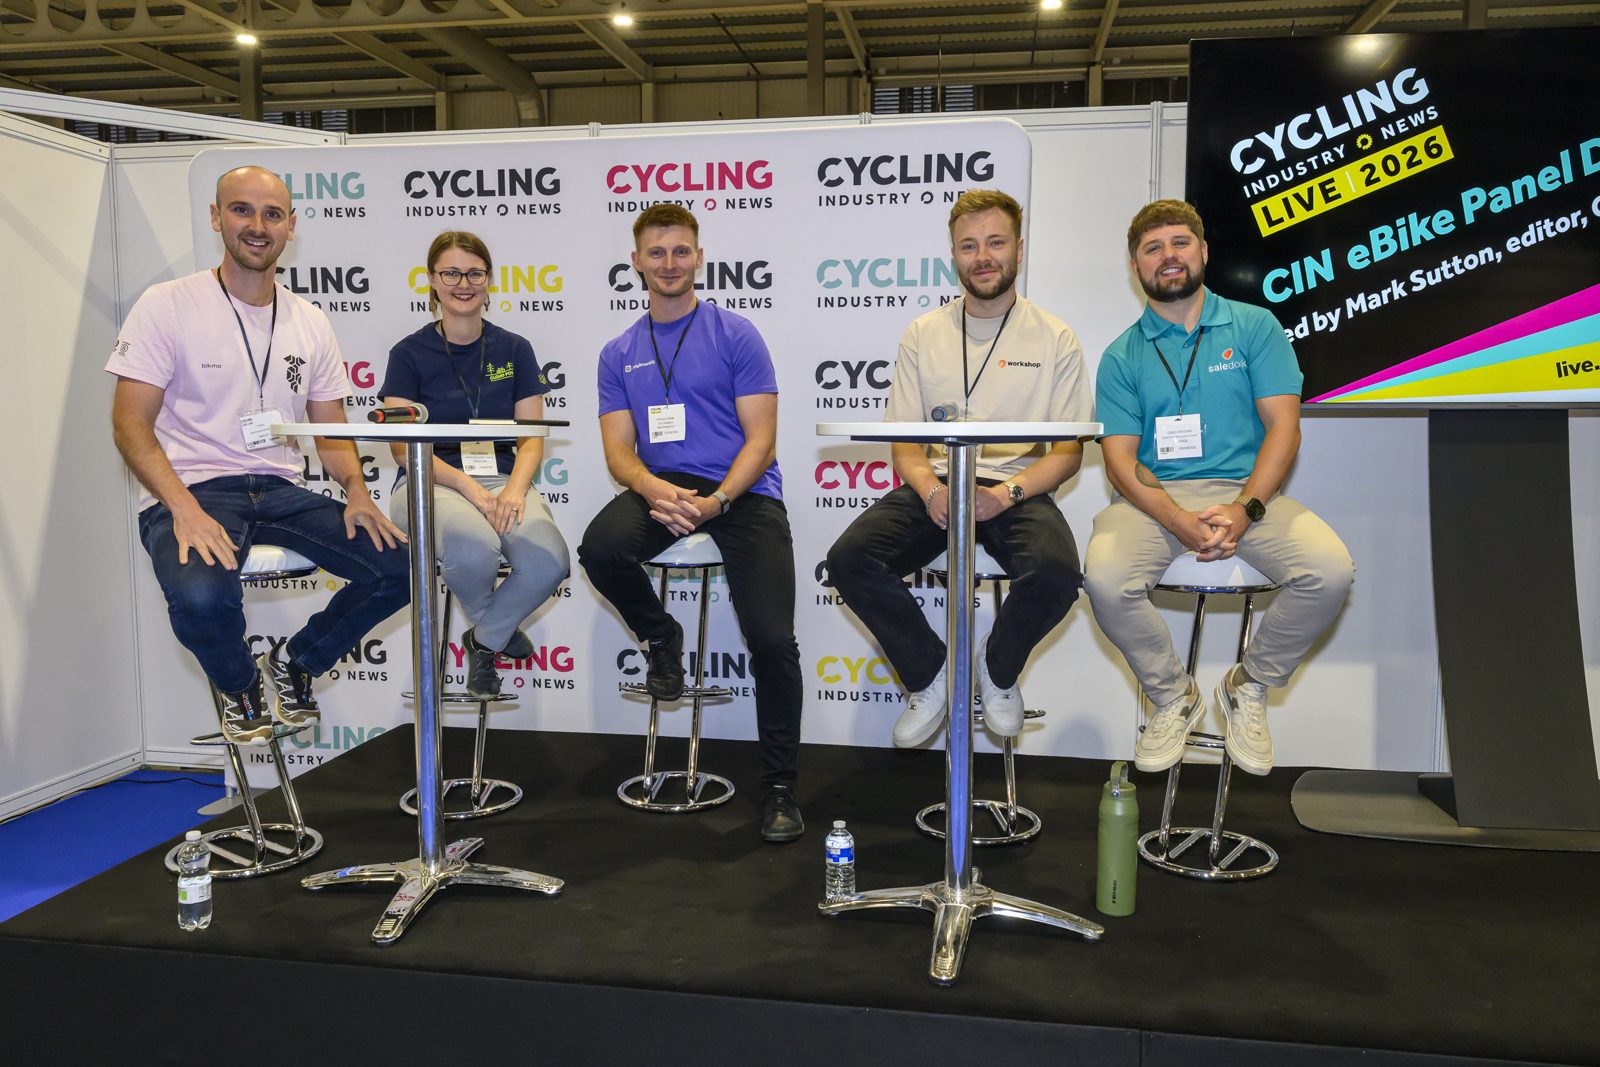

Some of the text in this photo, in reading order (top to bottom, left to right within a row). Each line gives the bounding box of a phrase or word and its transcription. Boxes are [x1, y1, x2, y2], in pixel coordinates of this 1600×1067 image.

[1230, 68, 1429, 174] CYCLING
[1242, 105, 1438, 198] INDUSTRY NEWS
[817, 151, 994, 188] CYCLING
[404, 167, 560, 199] CYCLING
[606, 160, 773, 194] CYCLING
[1261, 135, 1443, 228] LIVE 2026
[726, 197, 773, 209] NEWS
[818, 193, 911, 206] INDUSTRY
[324, 206, 366, 218] NEWS
[406, 203, 561, 217] INDUSTRY NEWS
[1262, 248, 1335, 303] CIN
[1347, 209, 1456, 270] eBike
[1461, 149, 1573, 225] Panel
[608, 260, 773, 292] CING
[816, 257, 959, 289] CYCLIN
[1312, 307, 1341, 332] by
[1346, 279, 1408, 319] Mark
[1410, 246, 1502, 292] Sutton,
[1506, 210, 1588, 253] editor,
[276, 266, 369, 294] LING
[408, 265, 563, 294] CING
[329, 301, 371, 312] NEWS
[520, 300, 564, 312] NEWS
[610, 297, 773, 310] INDU NEWS
[817, 295, 908, 308] INDUSTRY
[1007, 361, 1041, 369] workshop
[346, 395, 376, 406] EWS
[816, 397, 889, 408] INDUST
[347, 670, 388, 681] NEWS
[532, 678, 575, 690] NEWS
[818, 690, 904, 703] INDUSTRY
